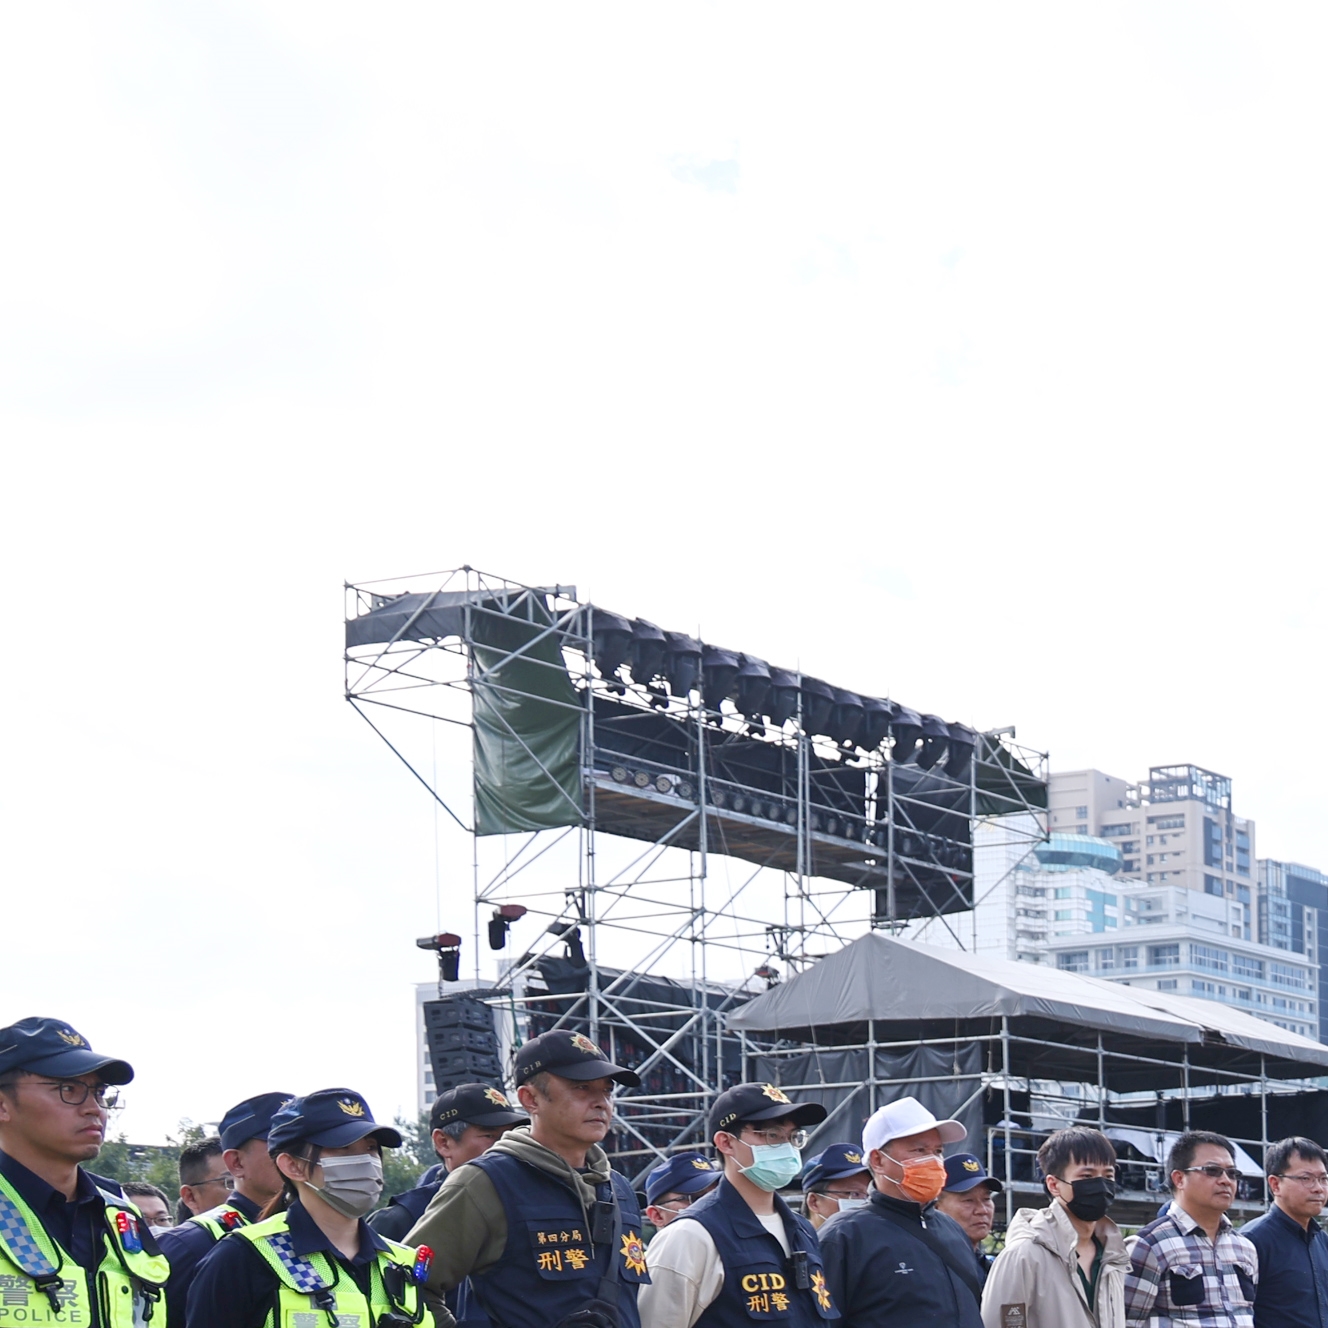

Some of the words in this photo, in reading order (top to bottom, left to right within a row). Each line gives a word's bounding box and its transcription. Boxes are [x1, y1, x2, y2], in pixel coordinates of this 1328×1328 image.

[439, 1108, 458, 1121] CID
[719, 1112, 737, 1127] CID
[536, 1229, 582, 1245] 第四分局
[536, 1248, 590, 1272] 刑警
[741, 1272, 786, 1293] CID
[746, 1292, 791, 1313] 刑警
